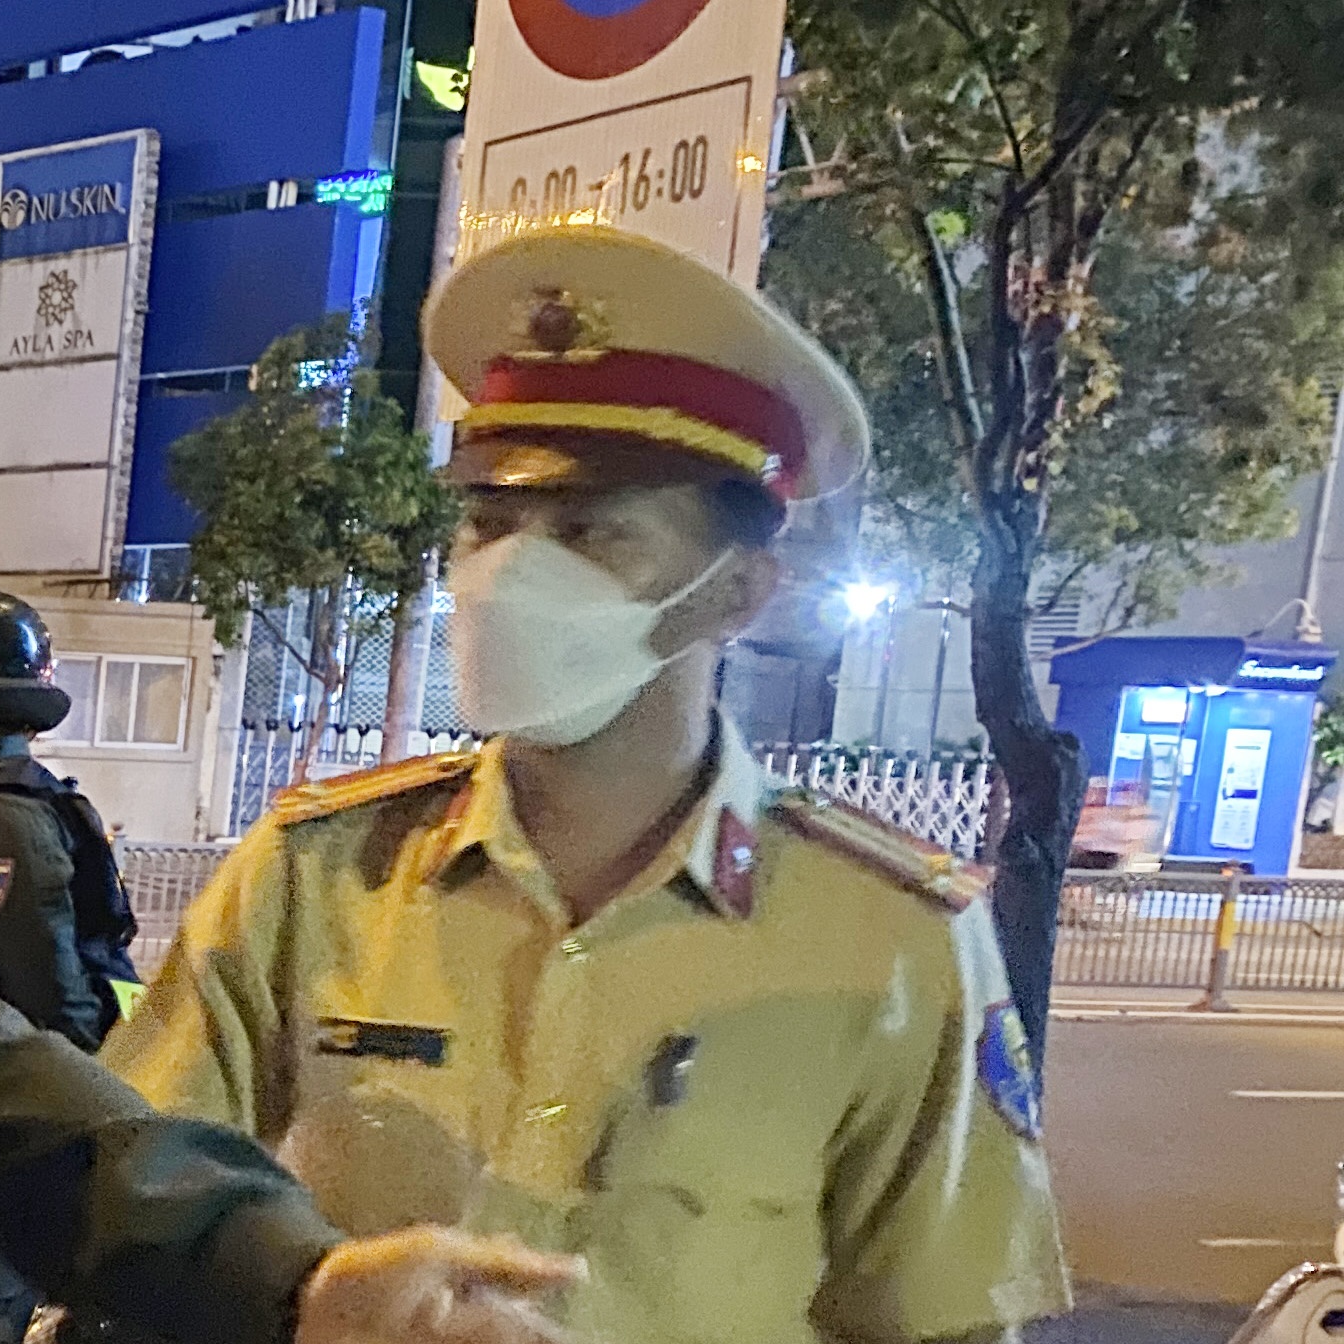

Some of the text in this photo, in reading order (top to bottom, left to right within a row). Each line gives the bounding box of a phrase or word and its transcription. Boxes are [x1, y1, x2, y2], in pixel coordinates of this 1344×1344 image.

[618, 134, 709, 215] 16:00
[9, 328, 95, 357] AYLA SPA
